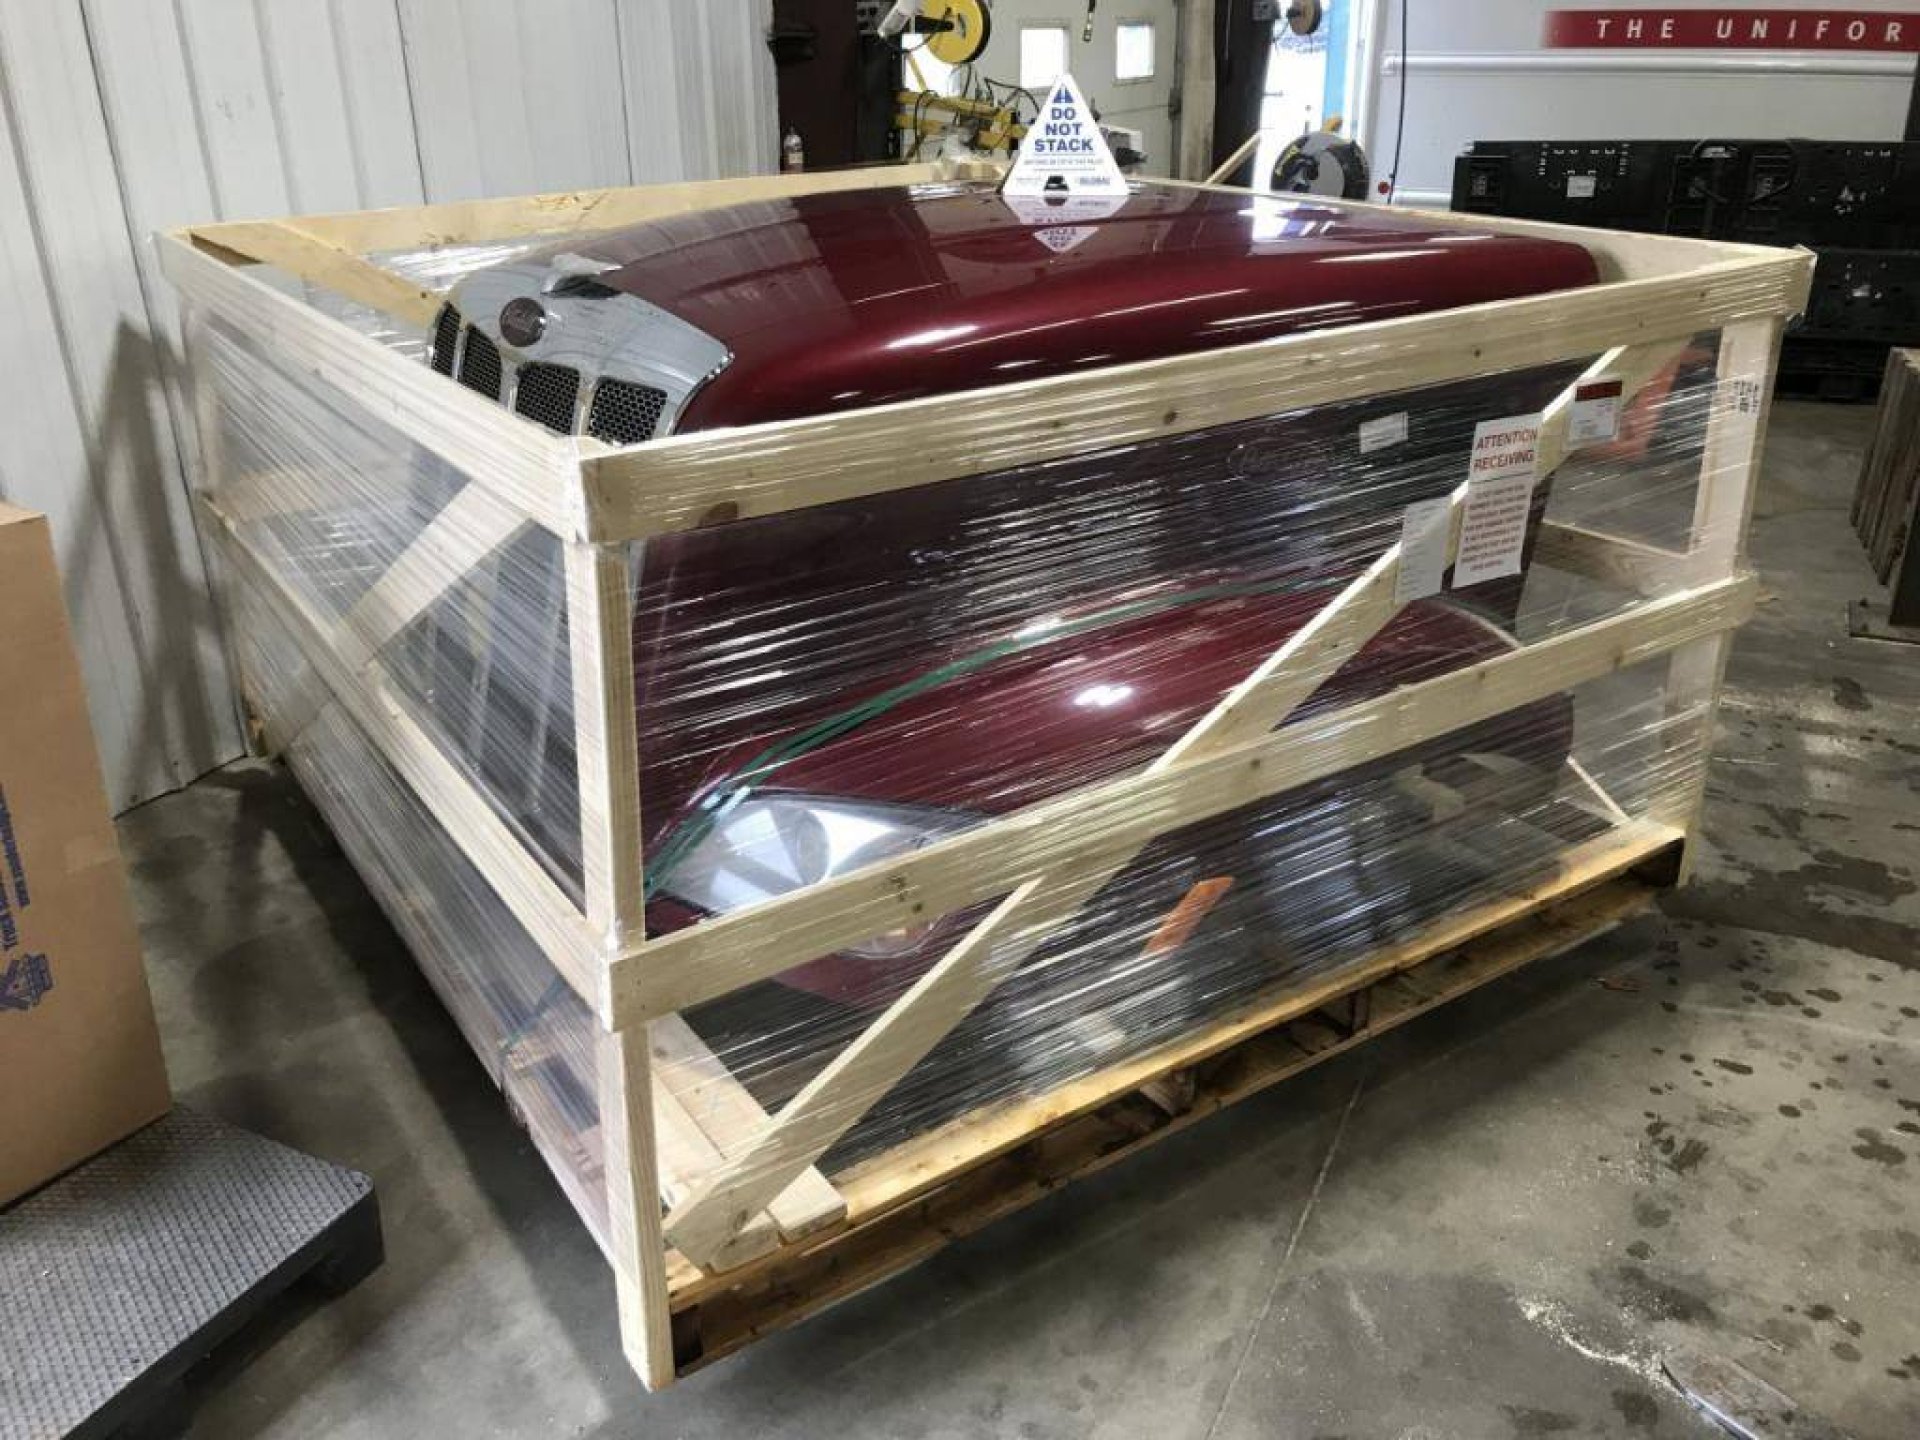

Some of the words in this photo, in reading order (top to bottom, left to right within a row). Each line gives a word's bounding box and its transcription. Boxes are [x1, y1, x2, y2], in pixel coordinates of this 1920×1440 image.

[1597, 18, 1675, 39] THE
[1716, 18, 1903, 42] UNIFOR
[1051, 108, 1076, 121] DO
[1045, 123, 1083, 136] NOT
[1034, 138, 1094, 153] STACK
[1475, 427, 1538, 450] ATTENTION
[1473, 449, 1535, 473] RECEIVING
